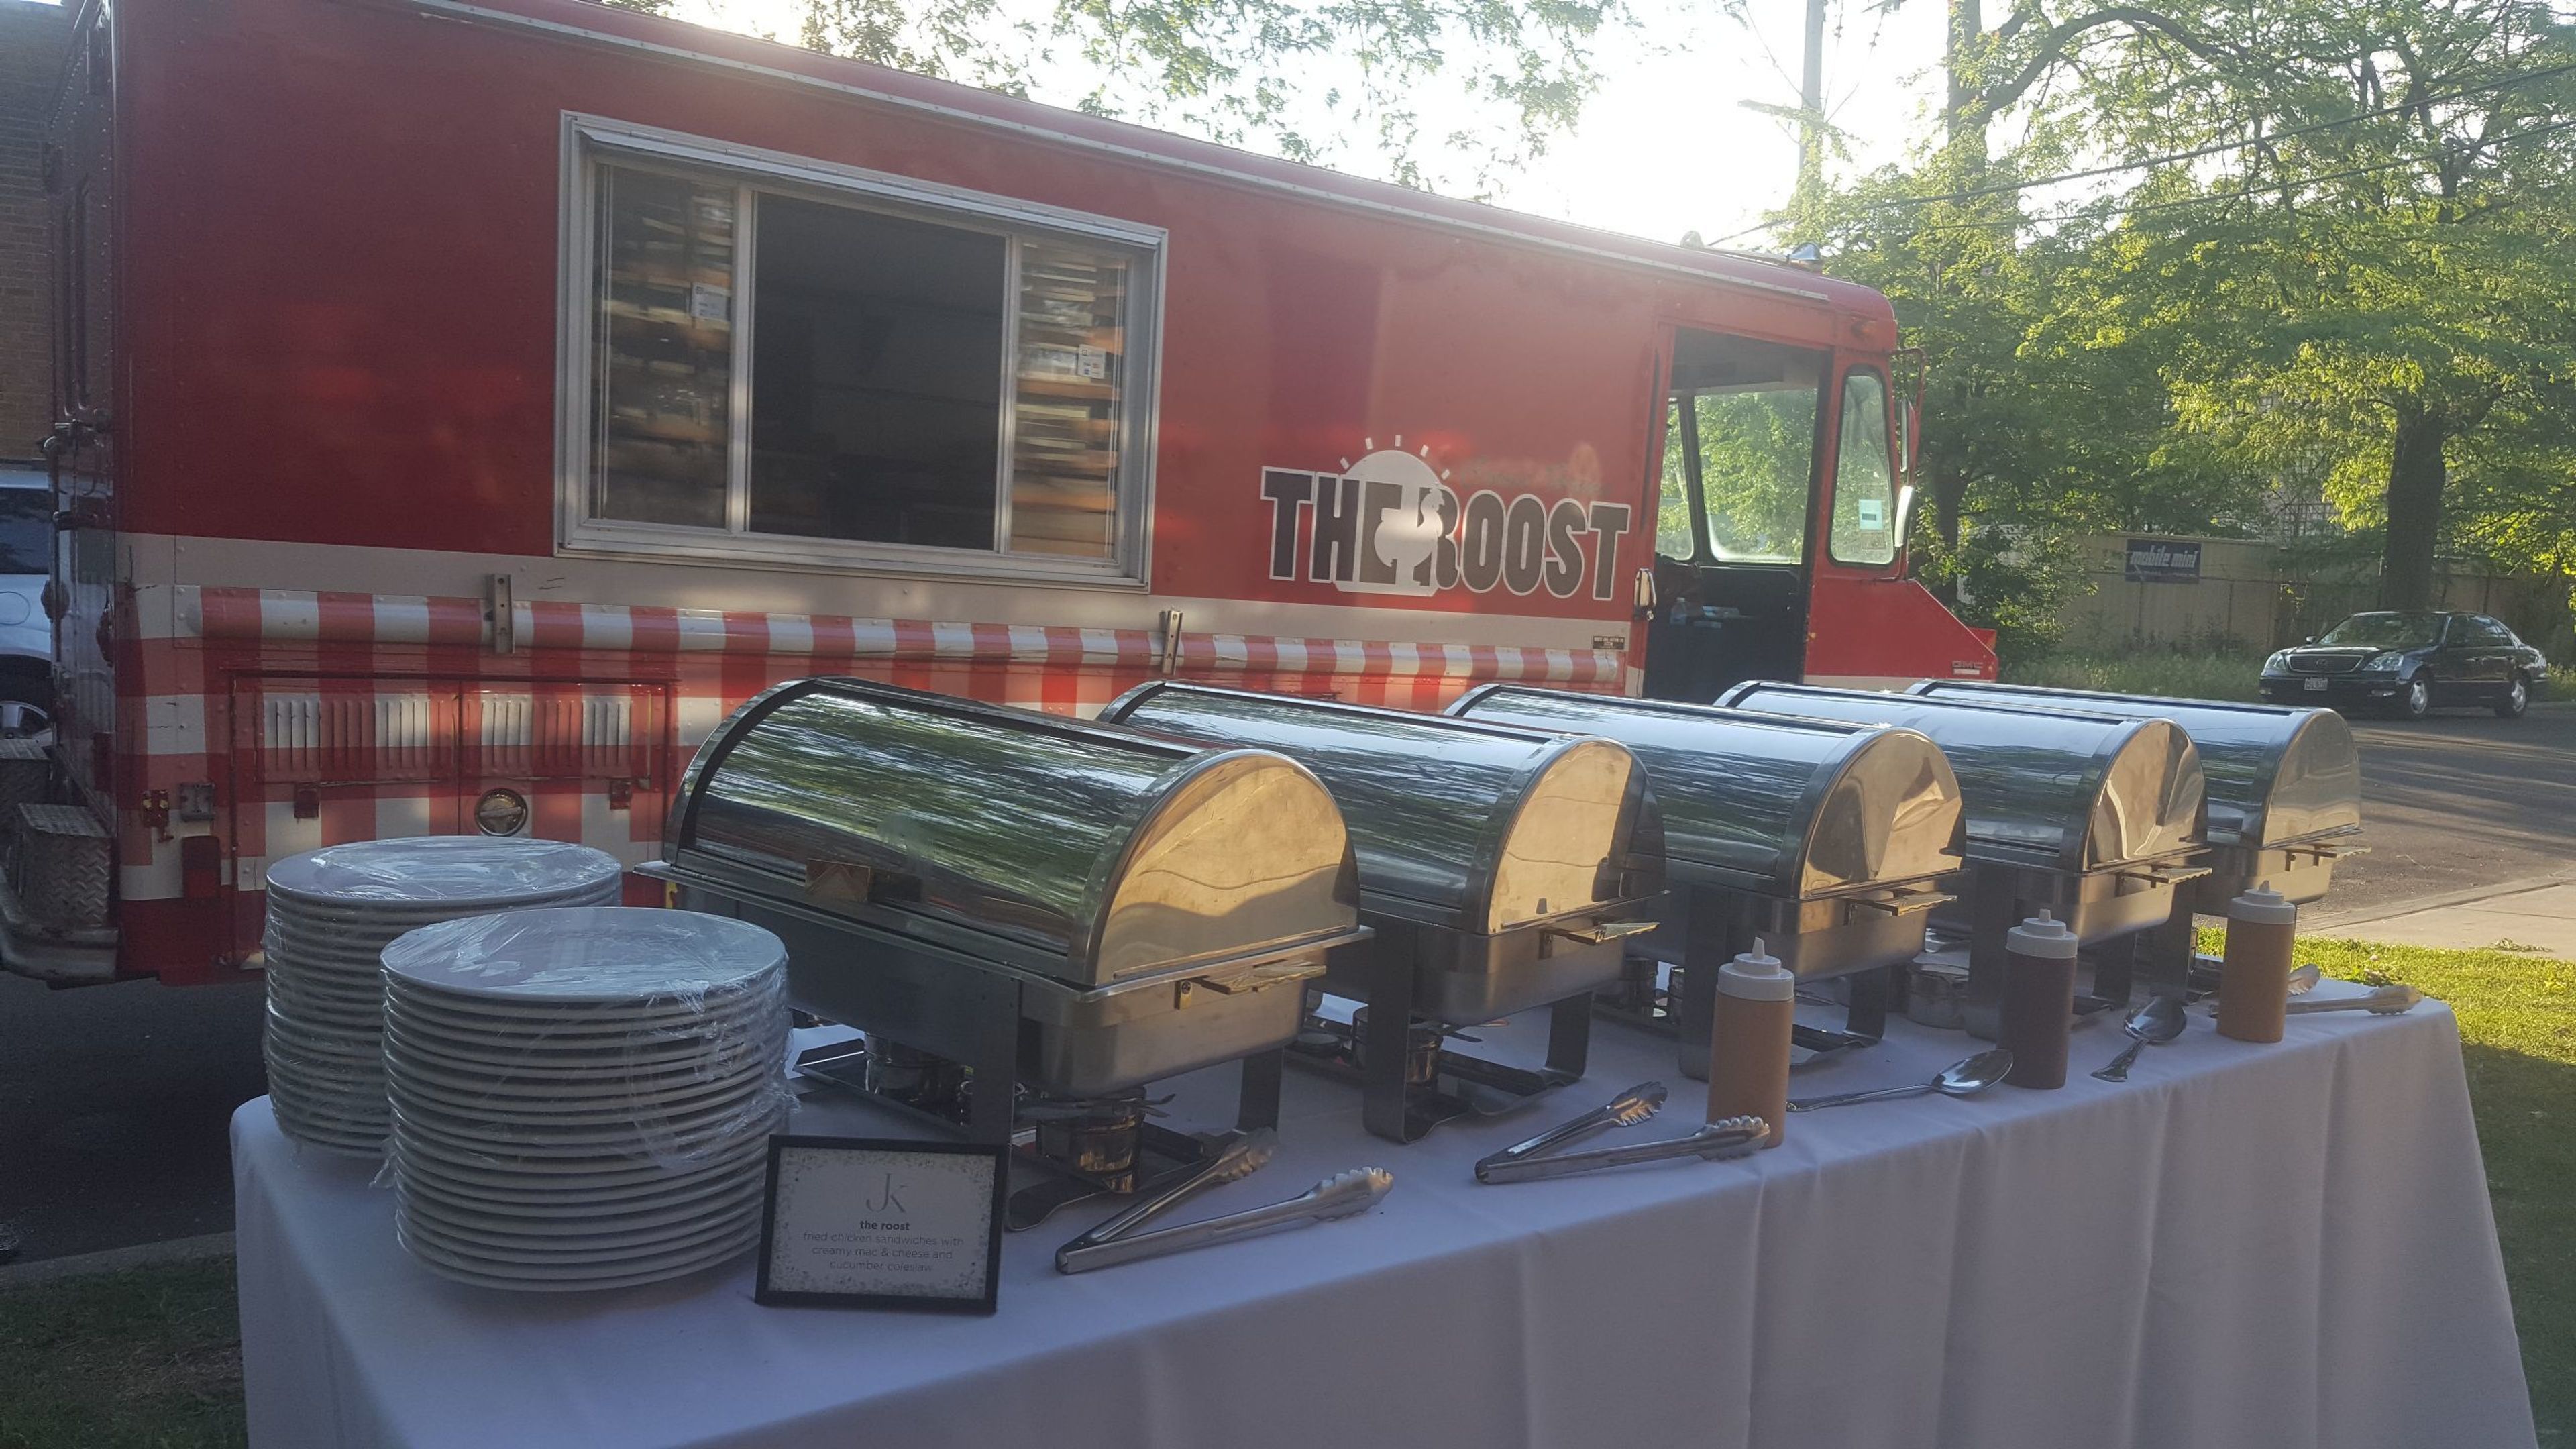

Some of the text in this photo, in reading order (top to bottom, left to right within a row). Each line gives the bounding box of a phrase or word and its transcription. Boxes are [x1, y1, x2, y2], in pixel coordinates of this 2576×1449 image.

[1260, 466, 1631, 600] THE ROOST
[859, 1220, 910, 1231] the roost
[804, 1232, 964, 1247] fried chicken sandwiches with
[811, 1246, 953, 1260] creamy mac & cheese and
[829, 1260, 933, 1272] cucumber coleslaw
